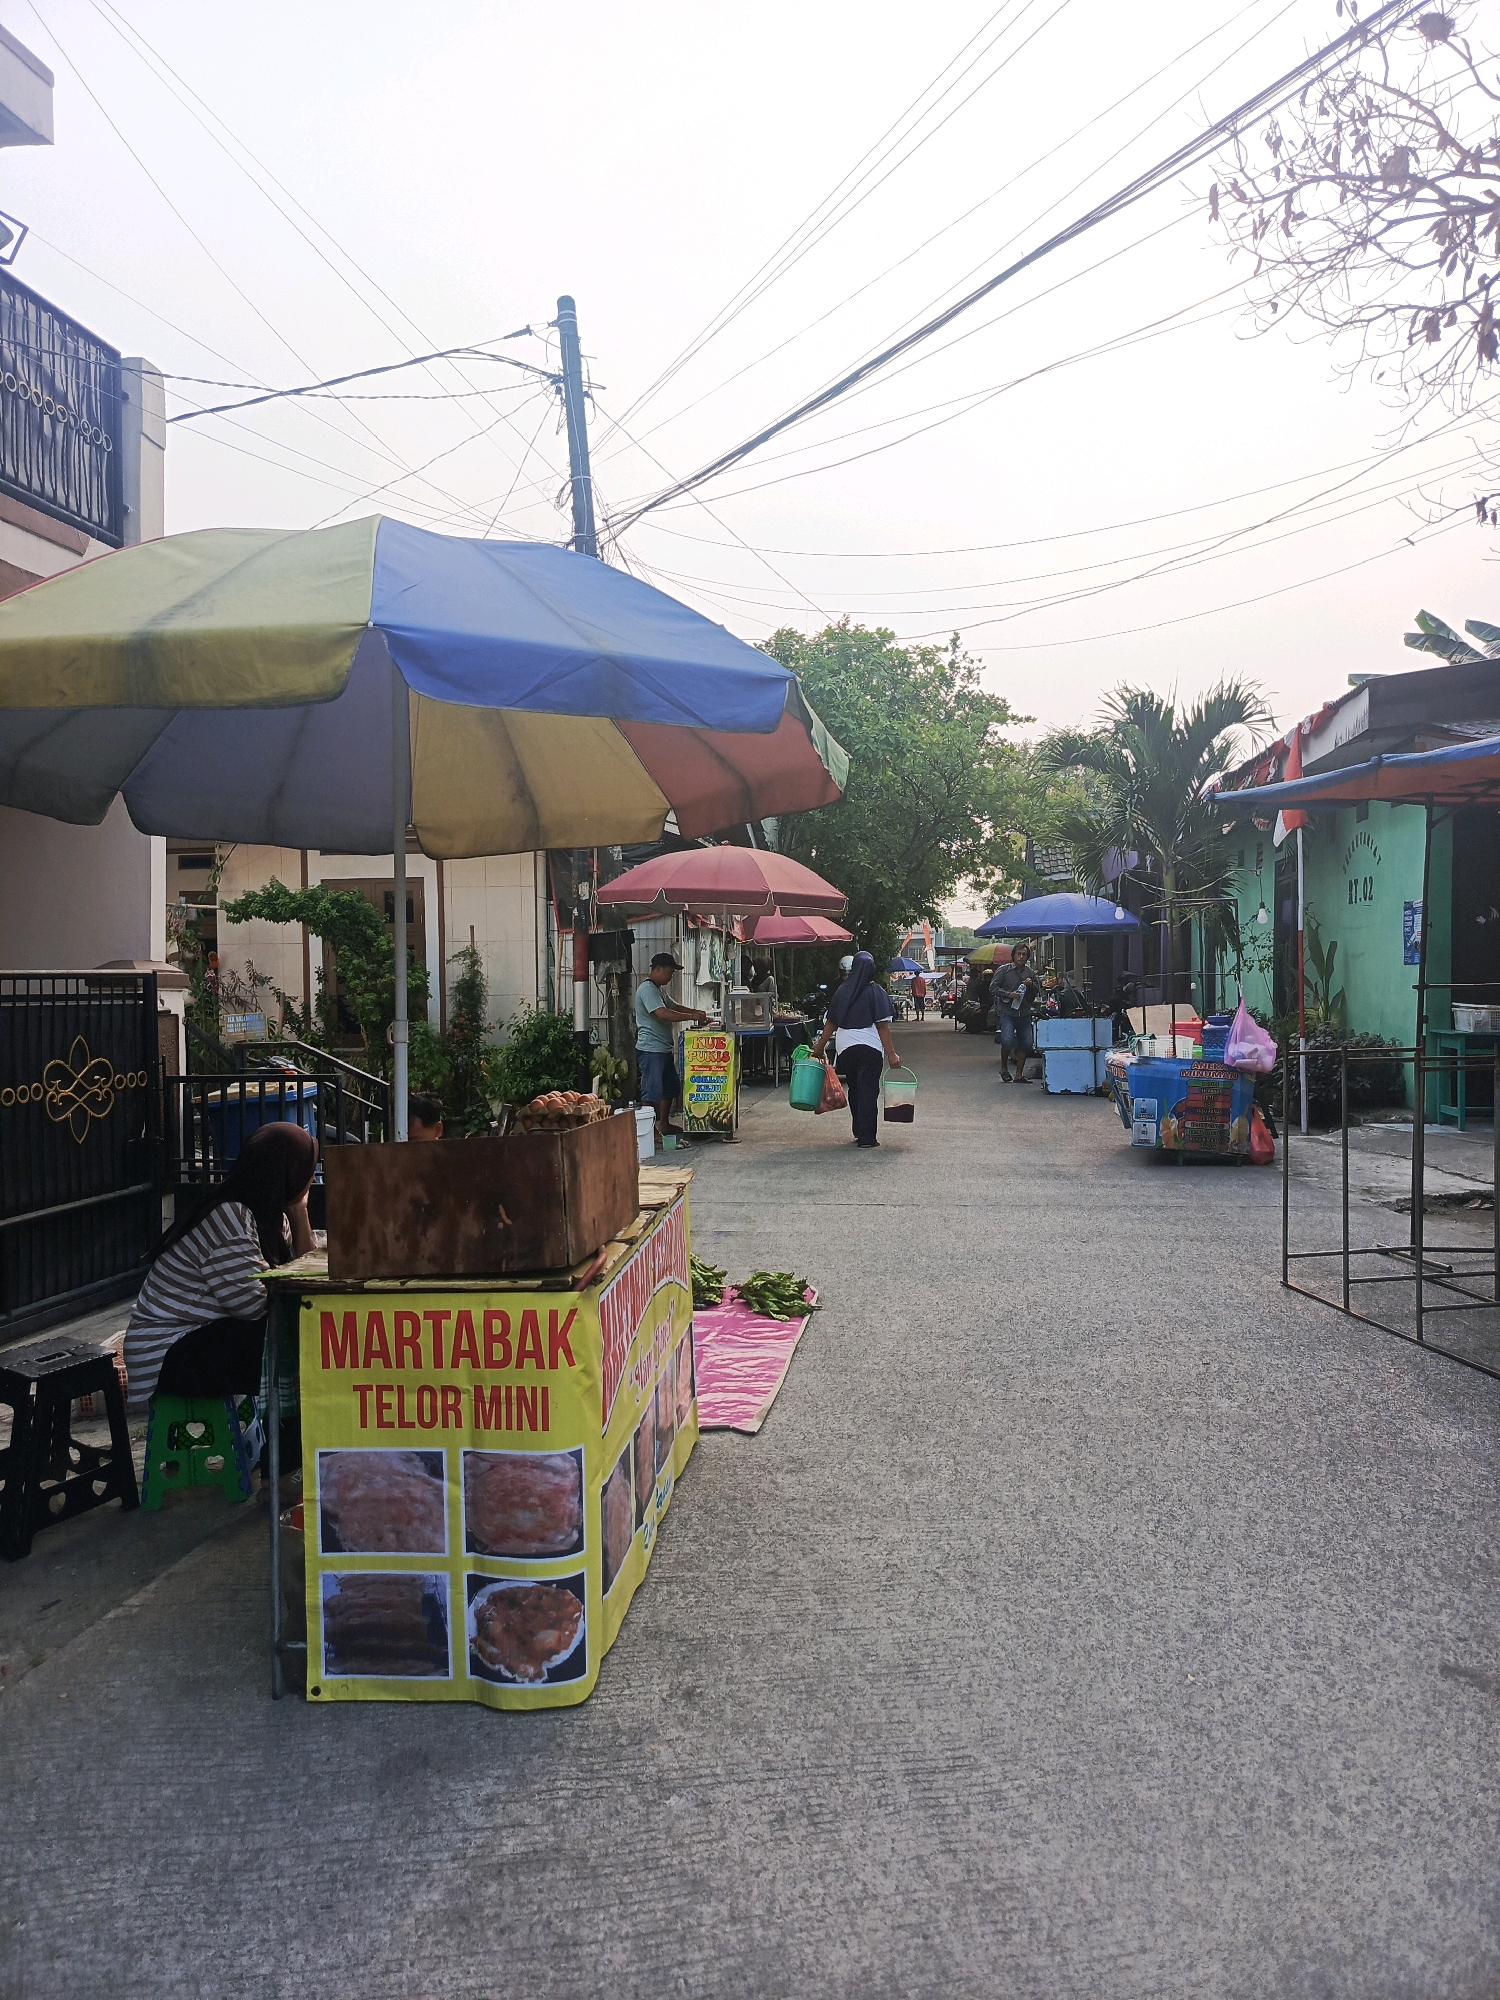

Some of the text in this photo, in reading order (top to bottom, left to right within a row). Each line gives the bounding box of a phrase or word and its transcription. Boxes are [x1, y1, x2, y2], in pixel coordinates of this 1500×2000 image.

[1348, 876, 1374, 905] RT.02
[692, 1036, 727, 1050] KUE
[688, 1051, 731, 1063] PUKIS
[1192, 1062, 1228, 1071] ANEKA
[690, 1075, 728, 1084] COKLAT
[1181, 1069, 1238, 1080] MINUMAN
[696, 1084, 722, 1092] KEJU
[689, 1093, 729, 1102] PANDAN
[320, 1308, 579, 1370] MARTABAK
[353, 1384, 549, 1432] TELOR MINI
